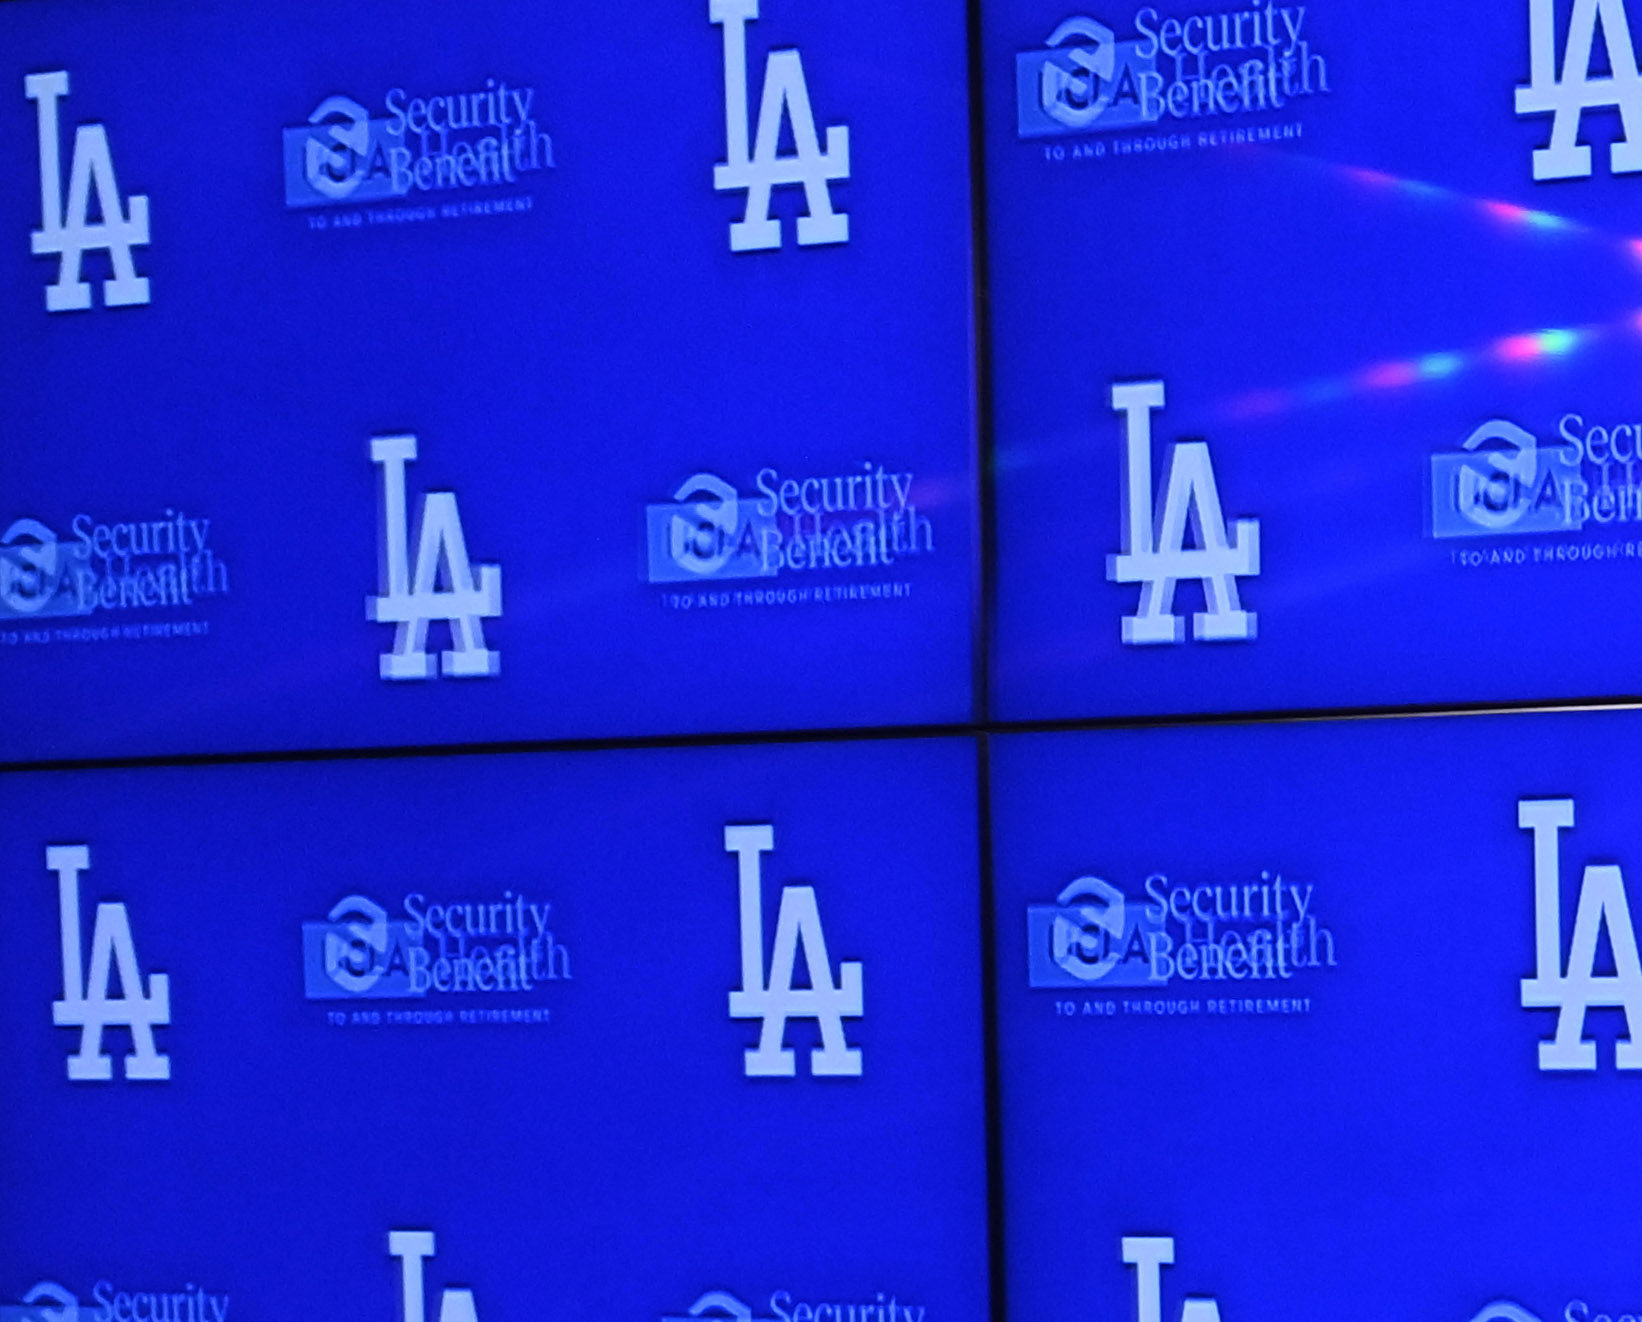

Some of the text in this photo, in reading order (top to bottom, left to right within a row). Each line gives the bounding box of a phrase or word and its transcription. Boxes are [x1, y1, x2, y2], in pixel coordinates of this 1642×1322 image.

[1134, 0, 1305, 55] Security
[385, 79, 533, 132] Security
[1137, 57, 1285, 120] Benefit
[710, 0, 849, 250] LA
[27, 72, 149, 310] LA
[755, 461, 913, 514] Security
[1111, 381, 1260, 644] LA
[71, 508, 209, 557] Security
[367, 436, 502, 679] LA
[403, 890, 550, 942] Security
[1144, 870, 1313, 926] Security
[47, 846, 170, 1080] LA
[725, 825, 864, 1076] LA
[1147, 927, 1294, 980] Benefit
